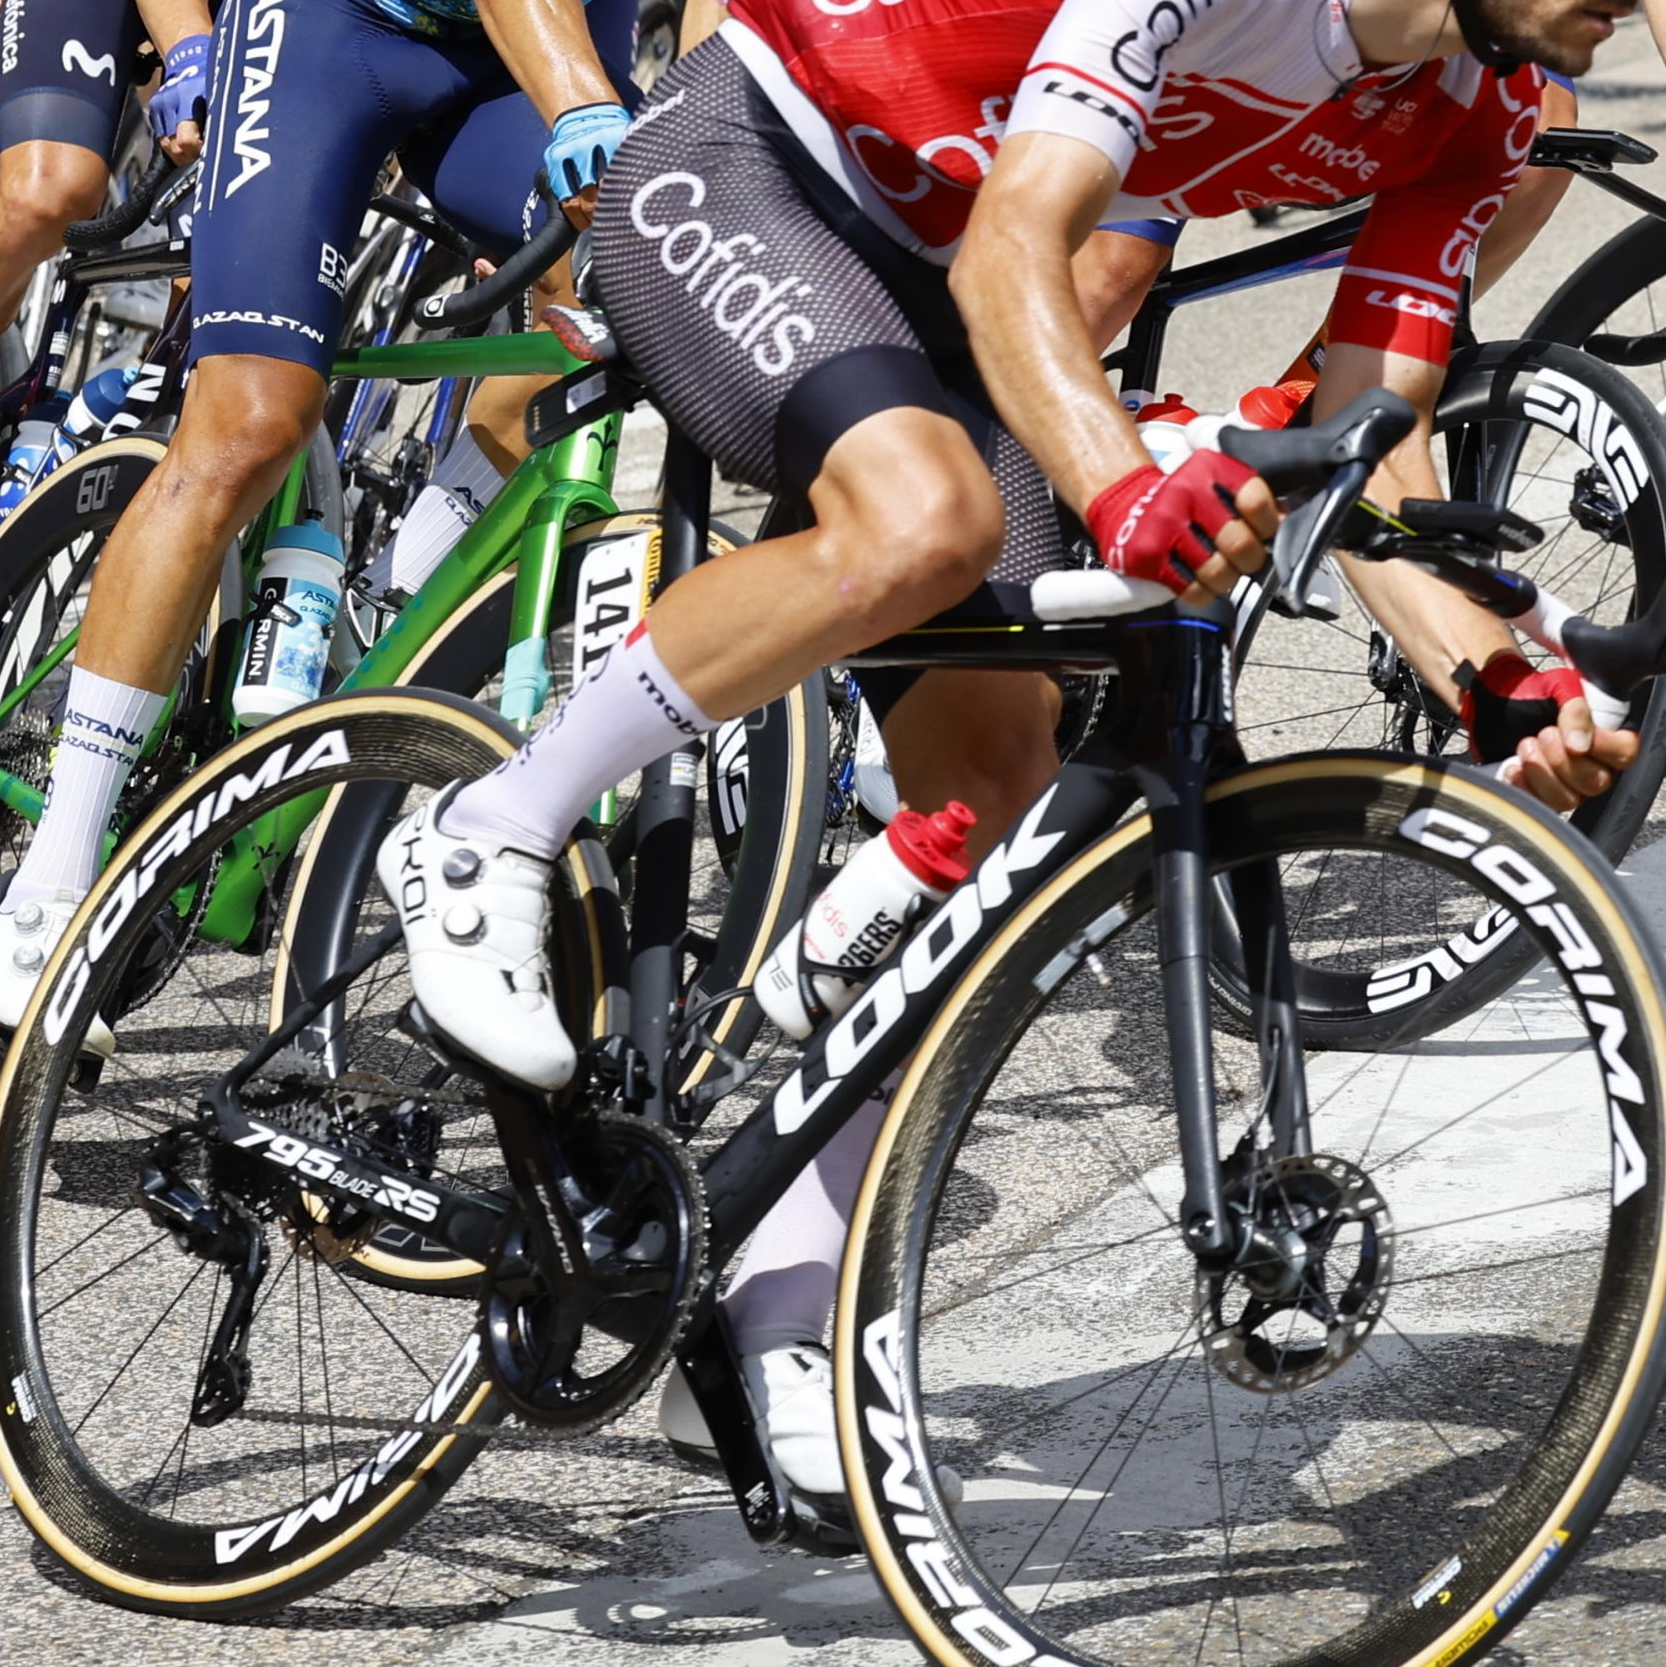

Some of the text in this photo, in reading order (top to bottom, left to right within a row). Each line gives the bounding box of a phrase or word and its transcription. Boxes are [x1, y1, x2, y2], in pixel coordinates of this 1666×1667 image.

[192, 310, 326, 345] QAZAQSTAN
[629, 170, 816, 377] Cofidis
[246, 585, 277, 683] GRMIN
[581, 566, 633, 673] 141
[64, 711, 145, 751] ASTANA
[44, 727, 353, 1046] CORIMA
[773, 783, 1066, 1137] LOOK
[1400, 806, 1651, 1209] CORIMA
[234, 1120, 442, 1224] 795 BLADE RS
[213, 1332, 485, 1565] ORIMA
[863, 1306, 1043, 1667] ORIMA
